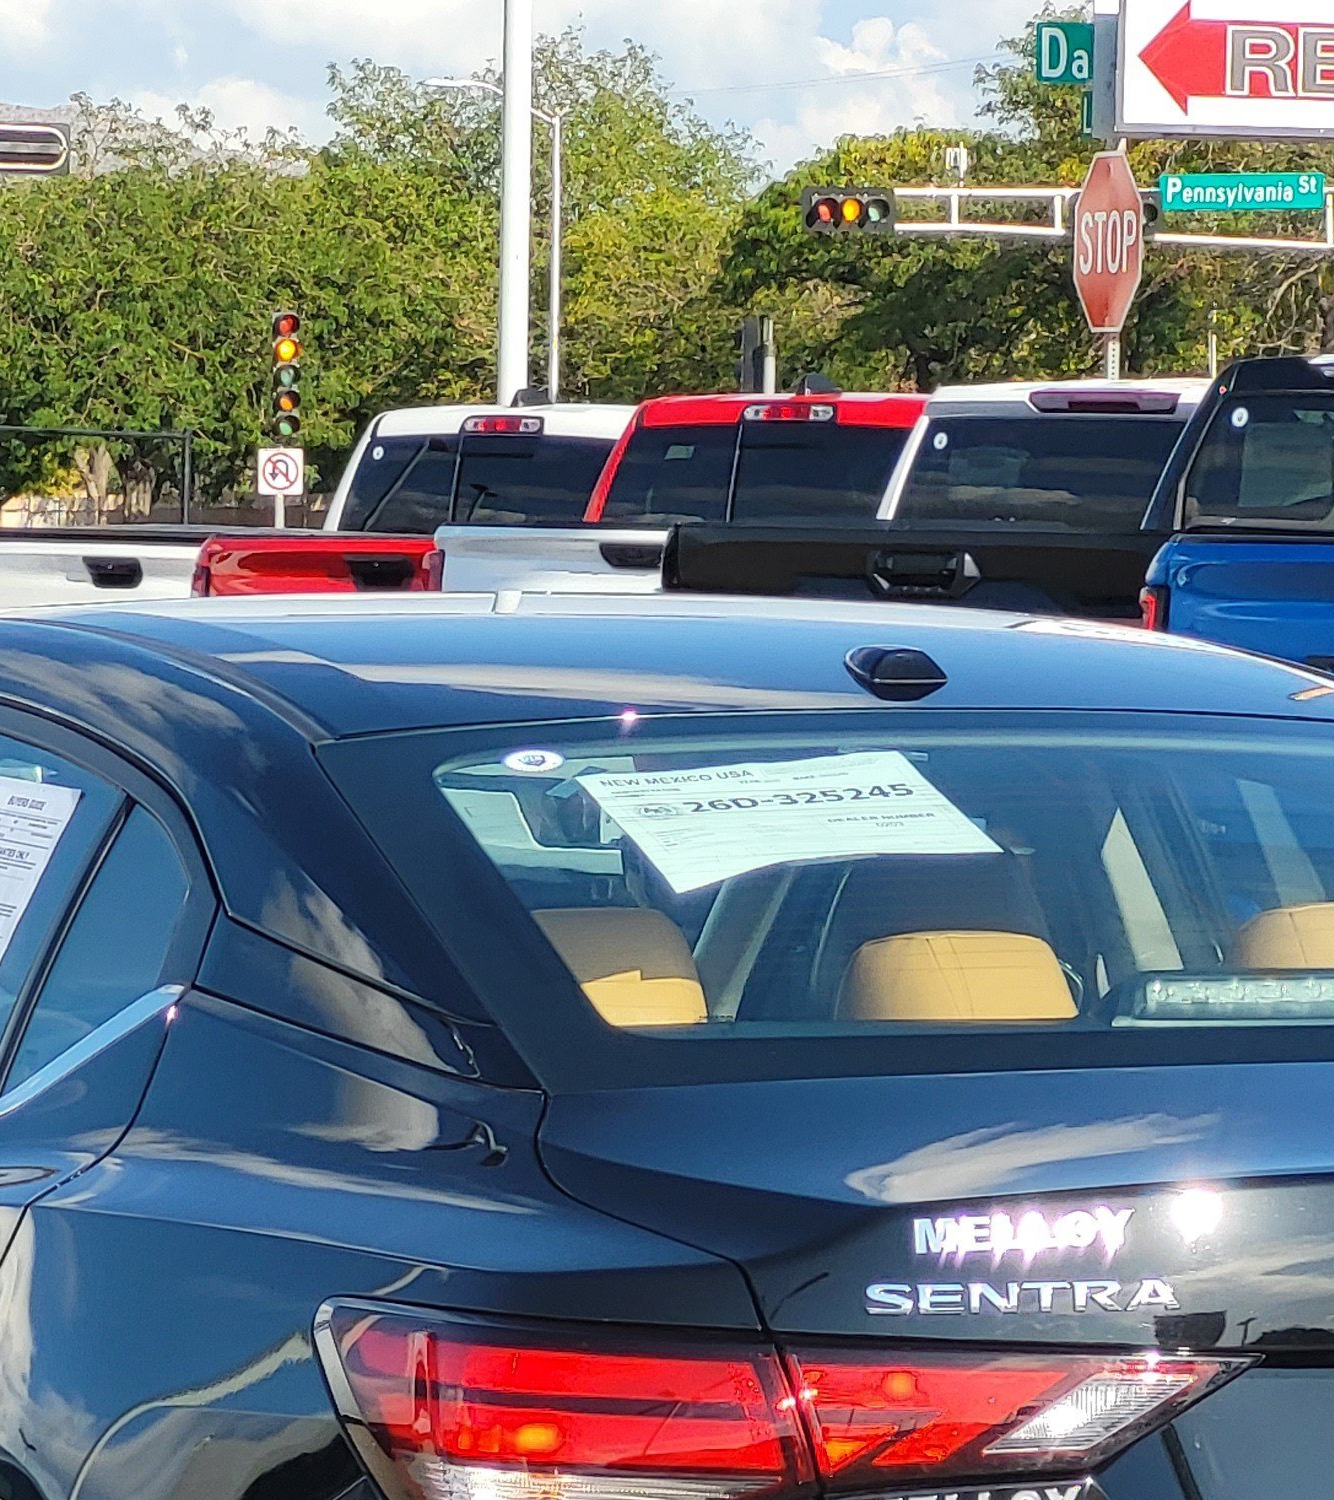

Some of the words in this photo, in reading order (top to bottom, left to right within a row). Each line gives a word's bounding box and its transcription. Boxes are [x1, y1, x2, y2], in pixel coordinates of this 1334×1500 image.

[1040, 26, 1089, 80] Da
[1166, 177, 1294, 207] Pennsylvania
[1298, 175, 1317, 194] St
[1079, 209, 1137, 275] STOP
[599, 778, 640, 788] NEW
[644, 774, 712, 786] MEXICO
[716, 769, 755, 780] USA
[682, 783, 915, 813] 26D-325245
[914, 1207, 1136, 1255] MELLOY
[865, 1278, 1181, 1316] SENTRA
